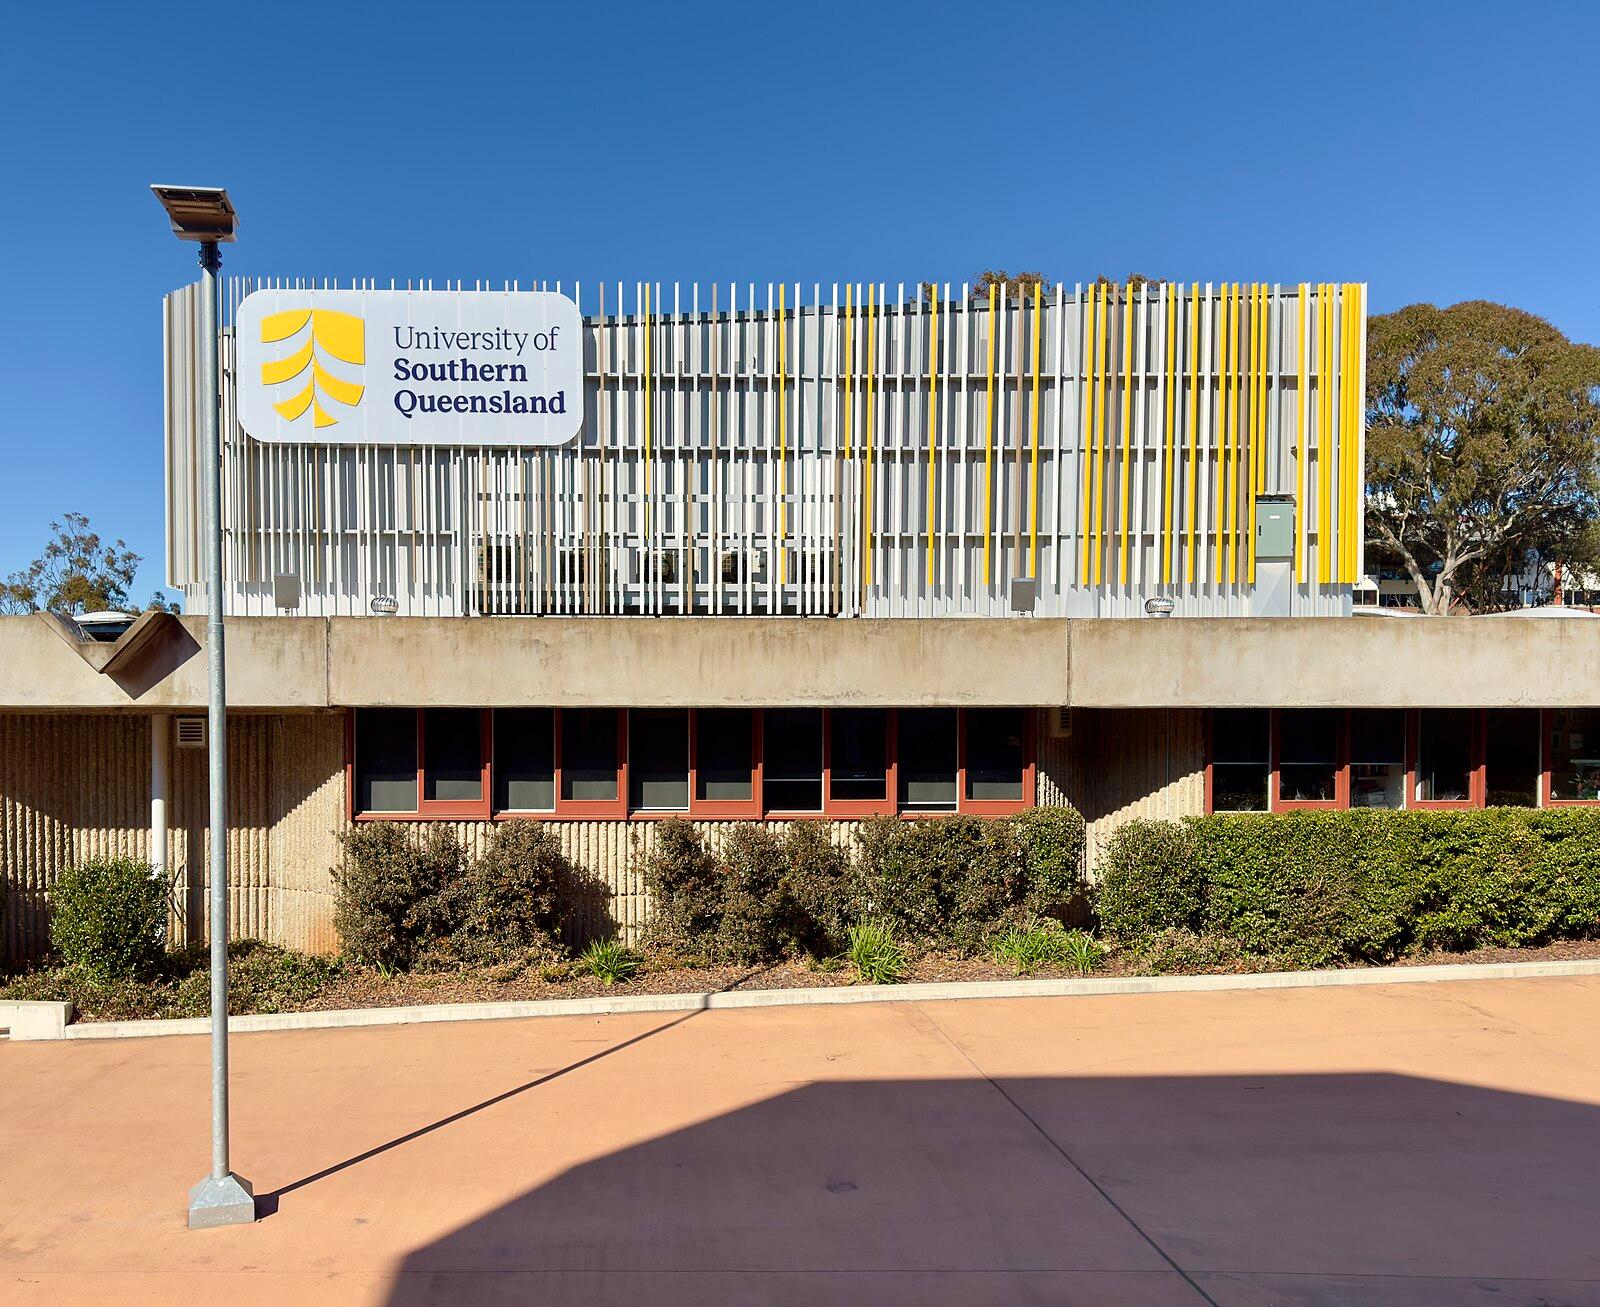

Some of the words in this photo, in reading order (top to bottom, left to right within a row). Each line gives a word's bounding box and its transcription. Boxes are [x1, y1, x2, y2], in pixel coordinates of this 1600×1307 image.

[393, 326, 529, 356] University
[534, 326, 560, 350] of
[394, 358, 528, 382] Southern
[394, 390, 566, 418] Queensland
